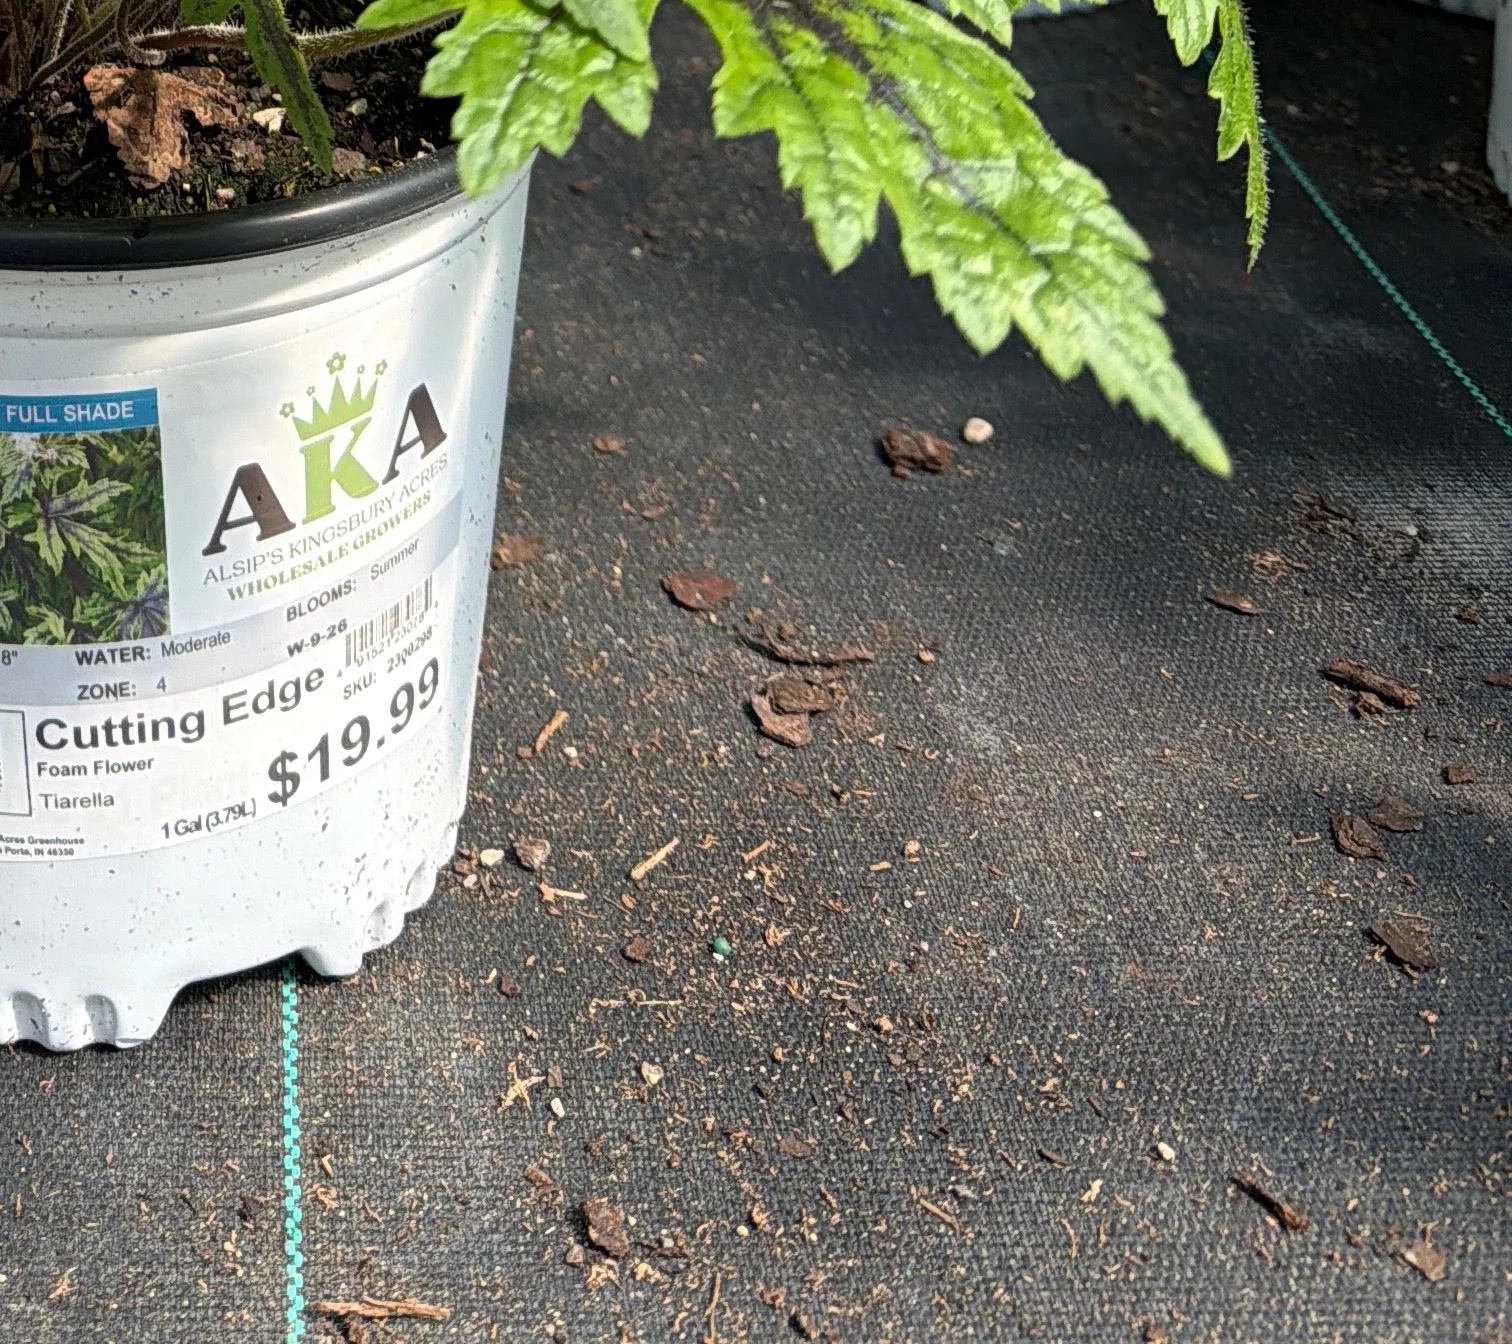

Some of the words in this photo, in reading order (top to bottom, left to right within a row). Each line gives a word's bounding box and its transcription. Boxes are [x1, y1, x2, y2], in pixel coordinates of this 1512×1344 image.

[6, 403, 58, 424] FULL
[63, 399, 135, 422] SHADE
[201, 382, 448, 557] AKA
[203, 546, 284, 586] ALSIP'S
[289, 489, 396, 561] KINGSBURY
[398, 452, 449, 503] ACRES
[227, 542, 350, 602] WHOLESALE
[352, 489, 433, 551] GROWERS
[75, 645, 152, 667] WATER:
[160, 629, 232, 659] Moderate
[286, 578, 358, 623] BLOOMS:
[370, 537, 420, 581] Summer
[286, 618, 349, 658] W-9-26
[76, 681, 138, 702] ZONE:
[156, 676, 168, 694] 4
[343, 671, 378, 701] SKU:
[35, 709, 206, 751] Cutting
[222, 666, 325, 727] Edge
[267, 656, 440, 807] $19.99
[37, 761, 88, 778] Foam
[93, 757, 154, 777] Flower
[39, 793, 115, 810] Tiarella
[161, 822, 170, 841] 1
[172, 817, 204, 838] Gal
[205, 797, 258, 833] (3.79L)
[27, 835, 85, 845] Greenhouse
[34, 848, 45, 856] IN
